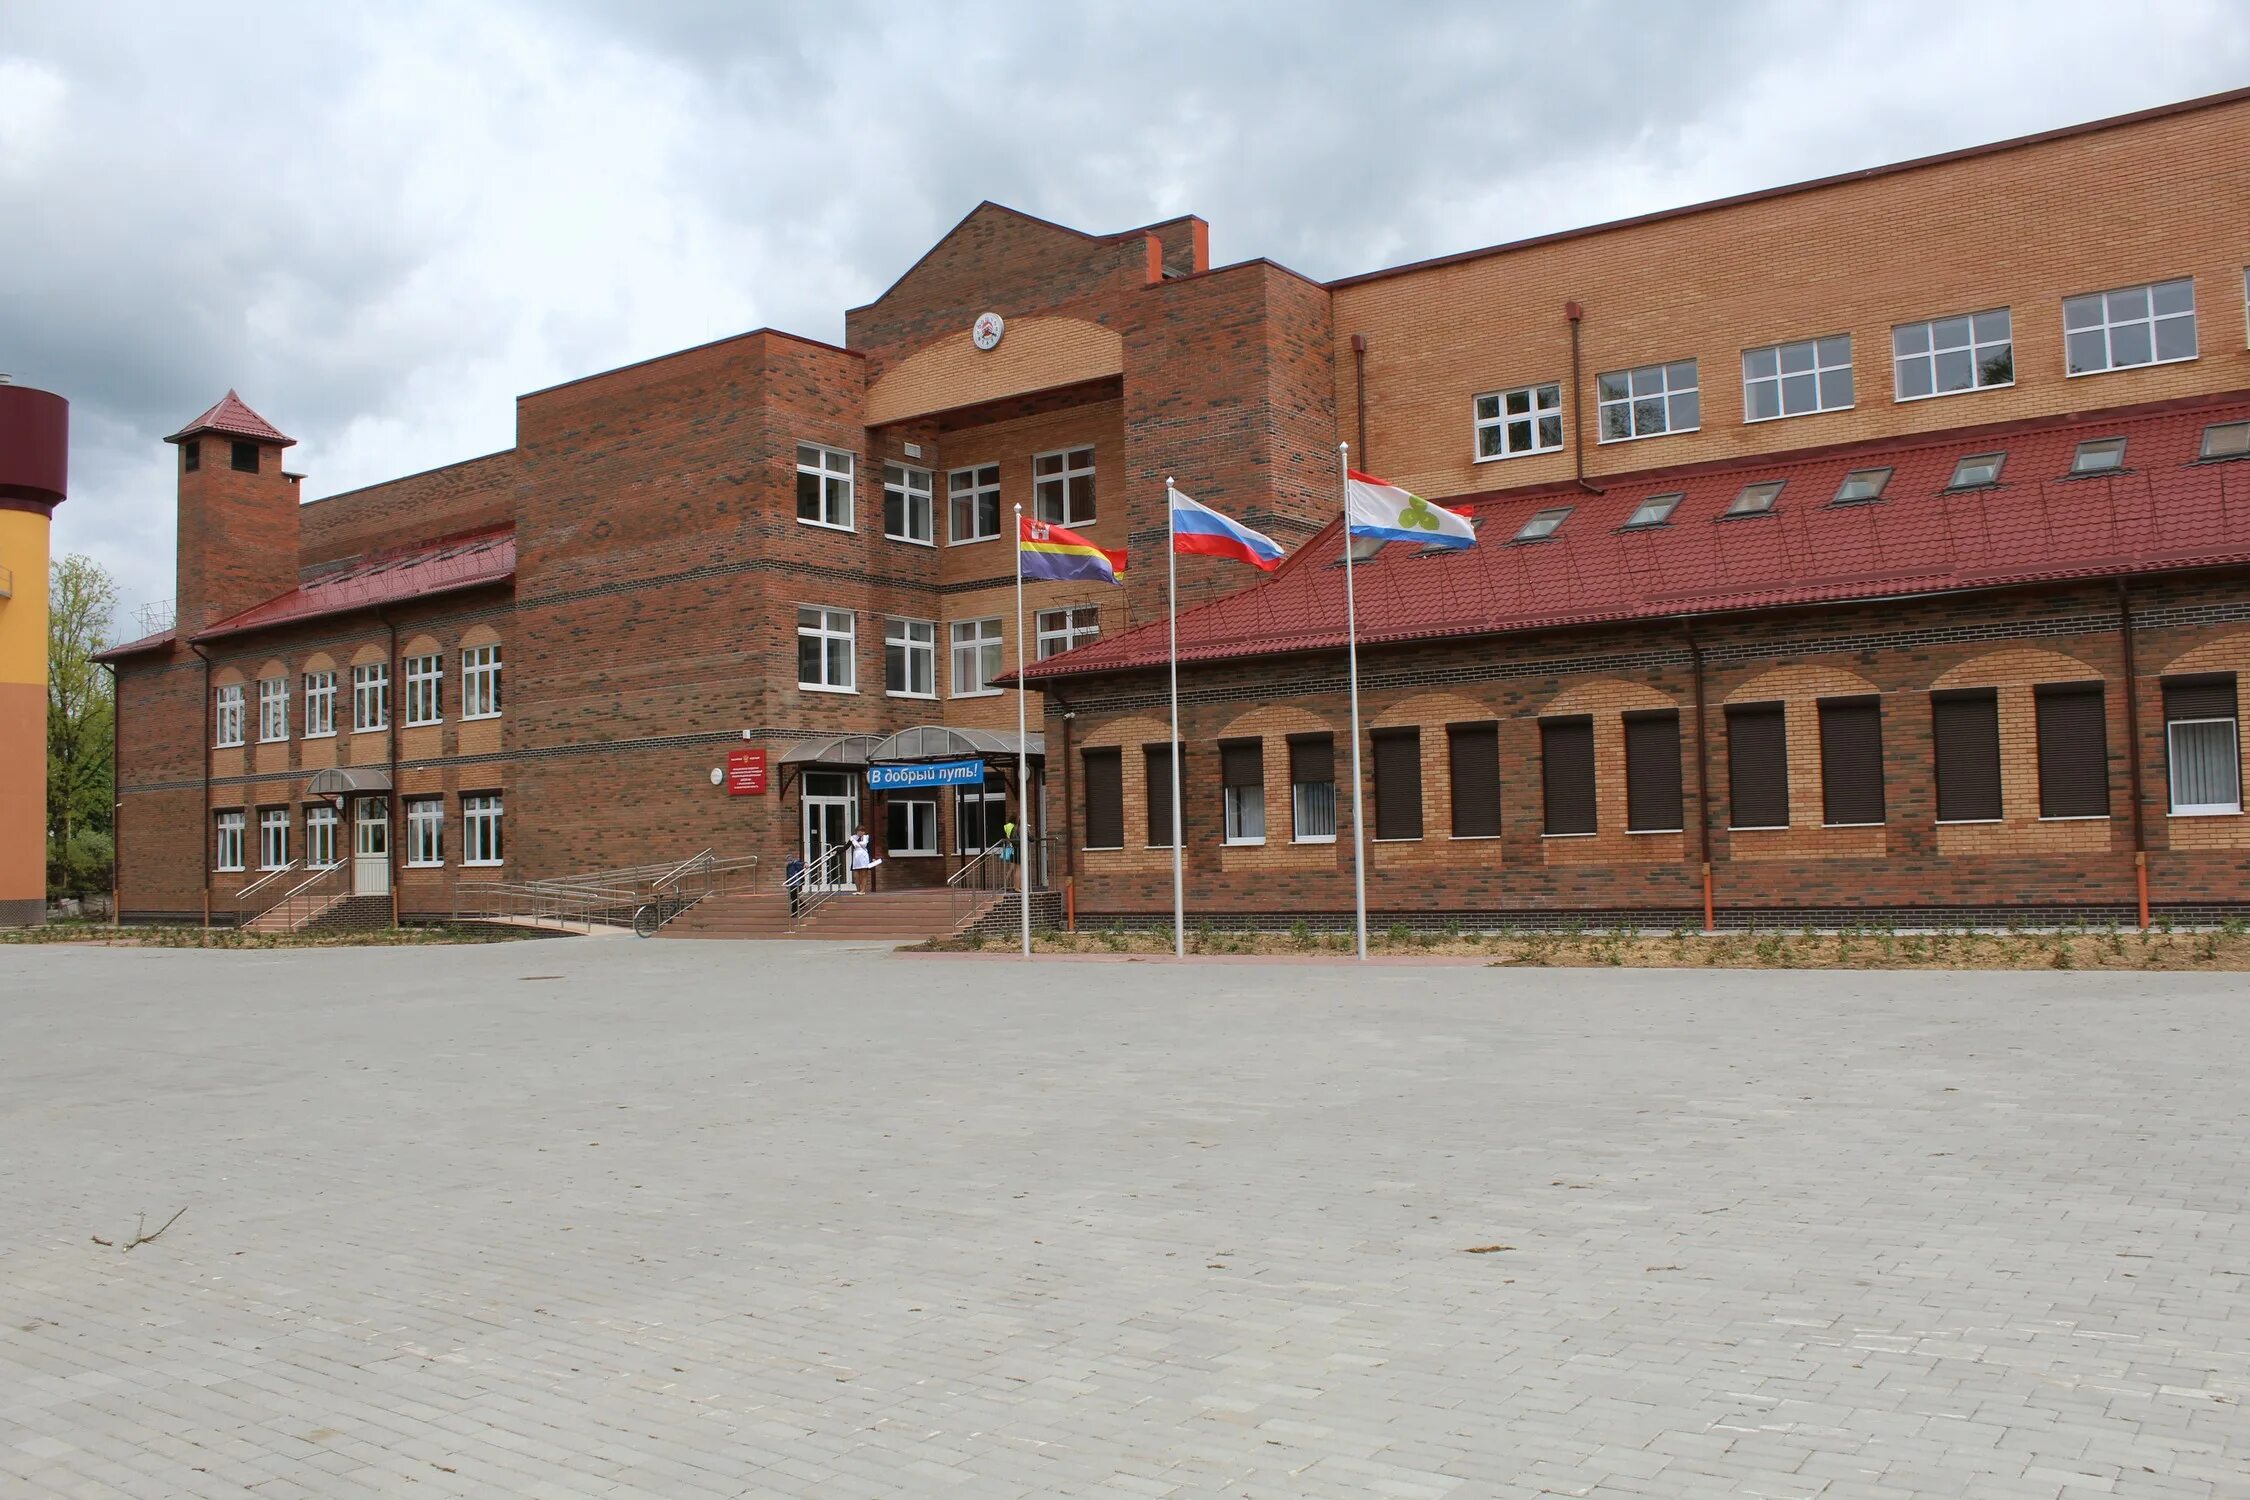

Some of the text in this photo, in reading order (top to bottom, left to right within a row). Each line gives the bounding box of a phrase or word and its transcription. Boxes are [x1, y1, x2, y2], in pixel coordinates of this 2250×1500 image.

[872, 763, 978, 784] В добрый путь!
